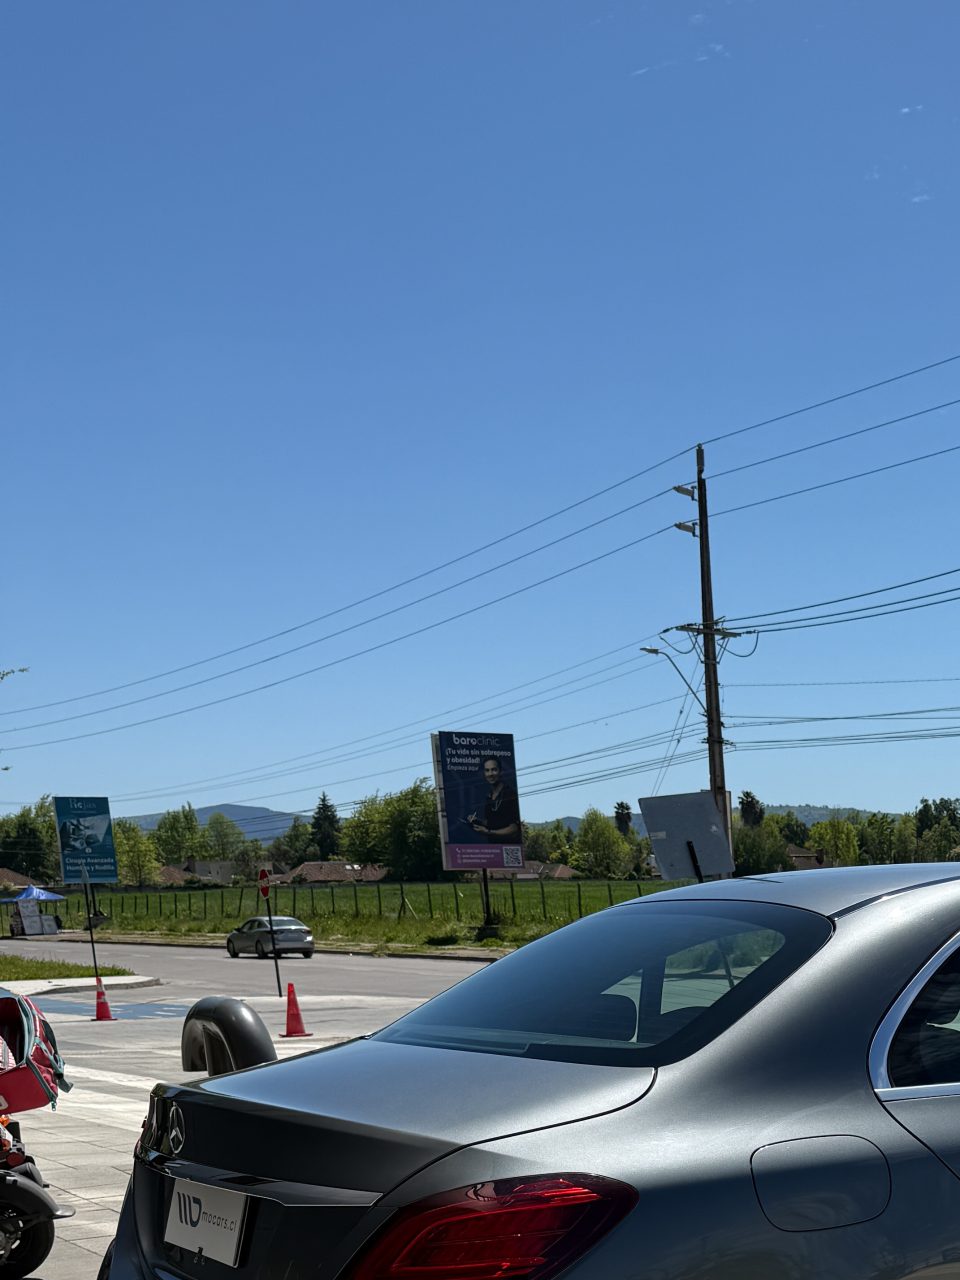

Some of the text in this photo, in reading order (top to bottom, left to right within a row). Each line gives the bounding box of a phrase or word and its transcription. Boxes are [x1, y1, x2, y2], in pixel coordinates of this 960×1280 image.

[452, 733, 500, 747] baroclinic
[480, 749, 511, 757] sobrepeso
[202, 1211, 237, 1233] mocars.cl
